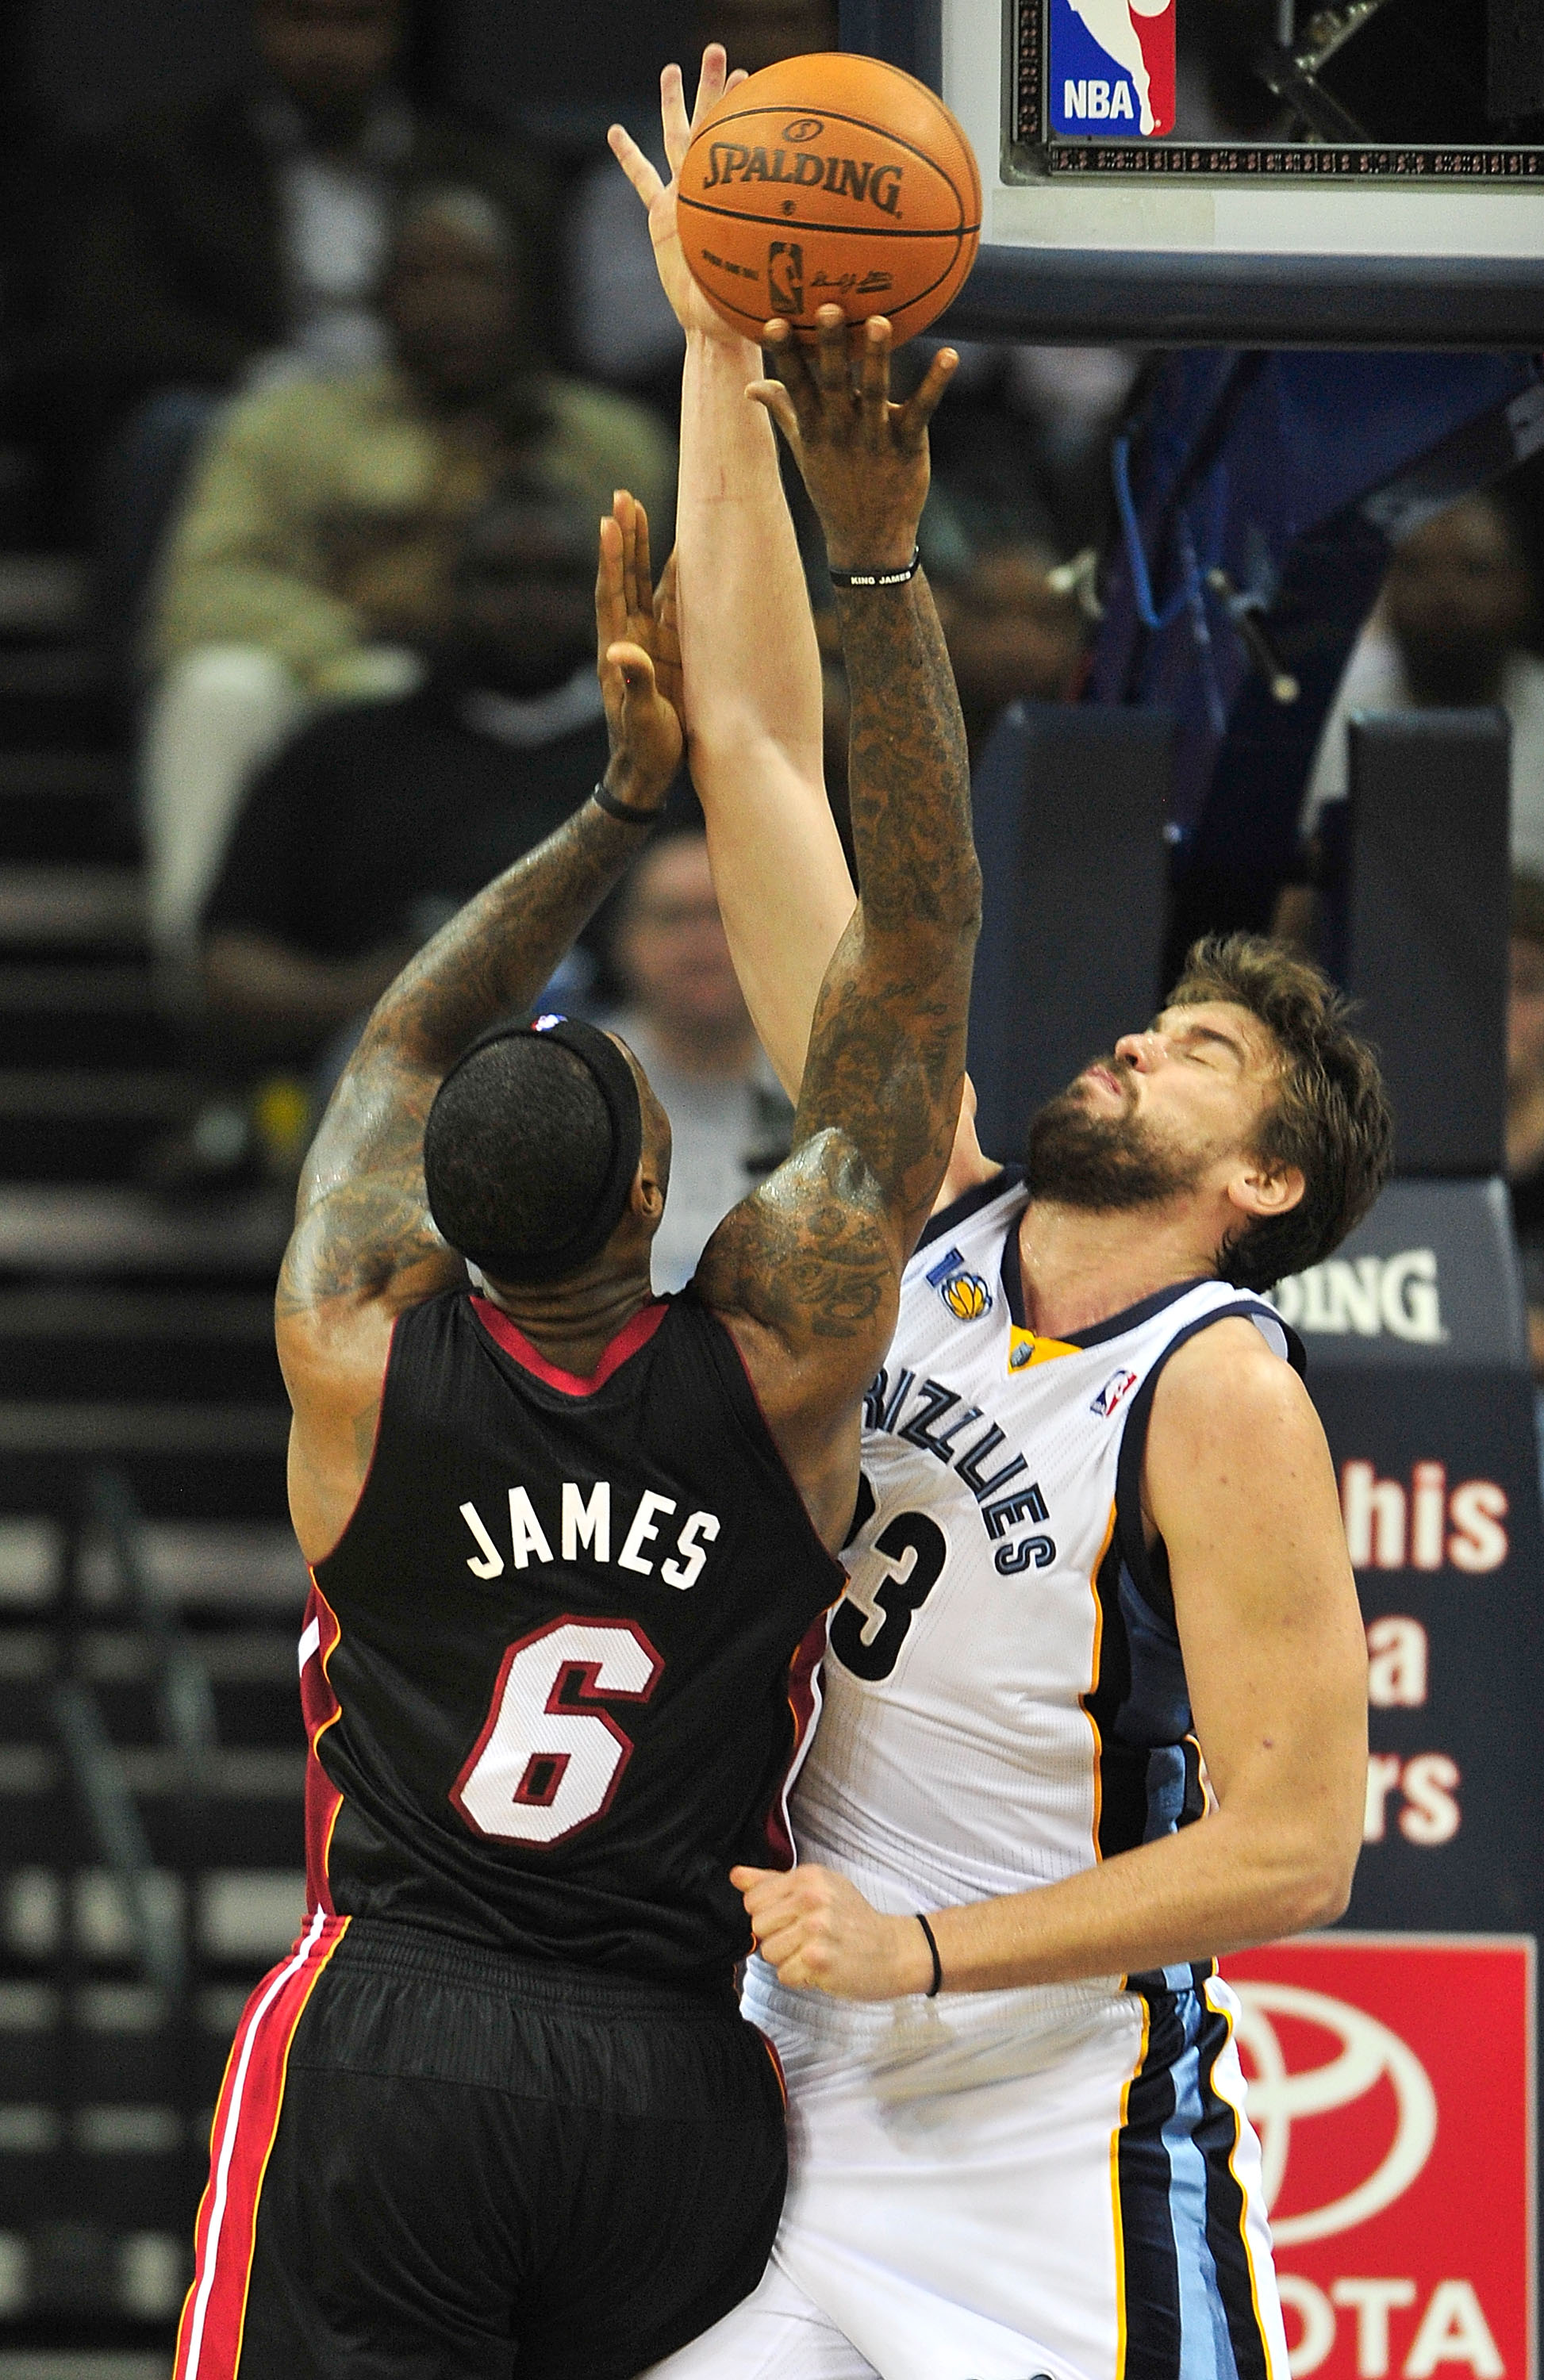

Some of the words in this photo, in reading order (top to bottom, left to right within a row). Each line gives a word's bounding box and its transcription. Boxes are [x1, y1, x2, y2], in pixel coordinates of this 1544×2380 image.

[1064, 79, 1134, 119] NBA
[703, 141, 903, 219] SPALDING
[851, 576, 875, 585] KING
[878, 570, 911, 585] JAMES
[1263, 1249, 1441, 1342] DING
[863, 1367, 1057, 1576] RIZZLIES
[1342, 1458, 1509, 1574] his
[459, 1481, 721, 1590] JAMES
[1365, 1614, 1429, 1709] a
[449, 1614, 666, 1851] 6
[1363, 1752, 1462, 1847] rs
[1276, 2273, 1506, 2379] OTA
